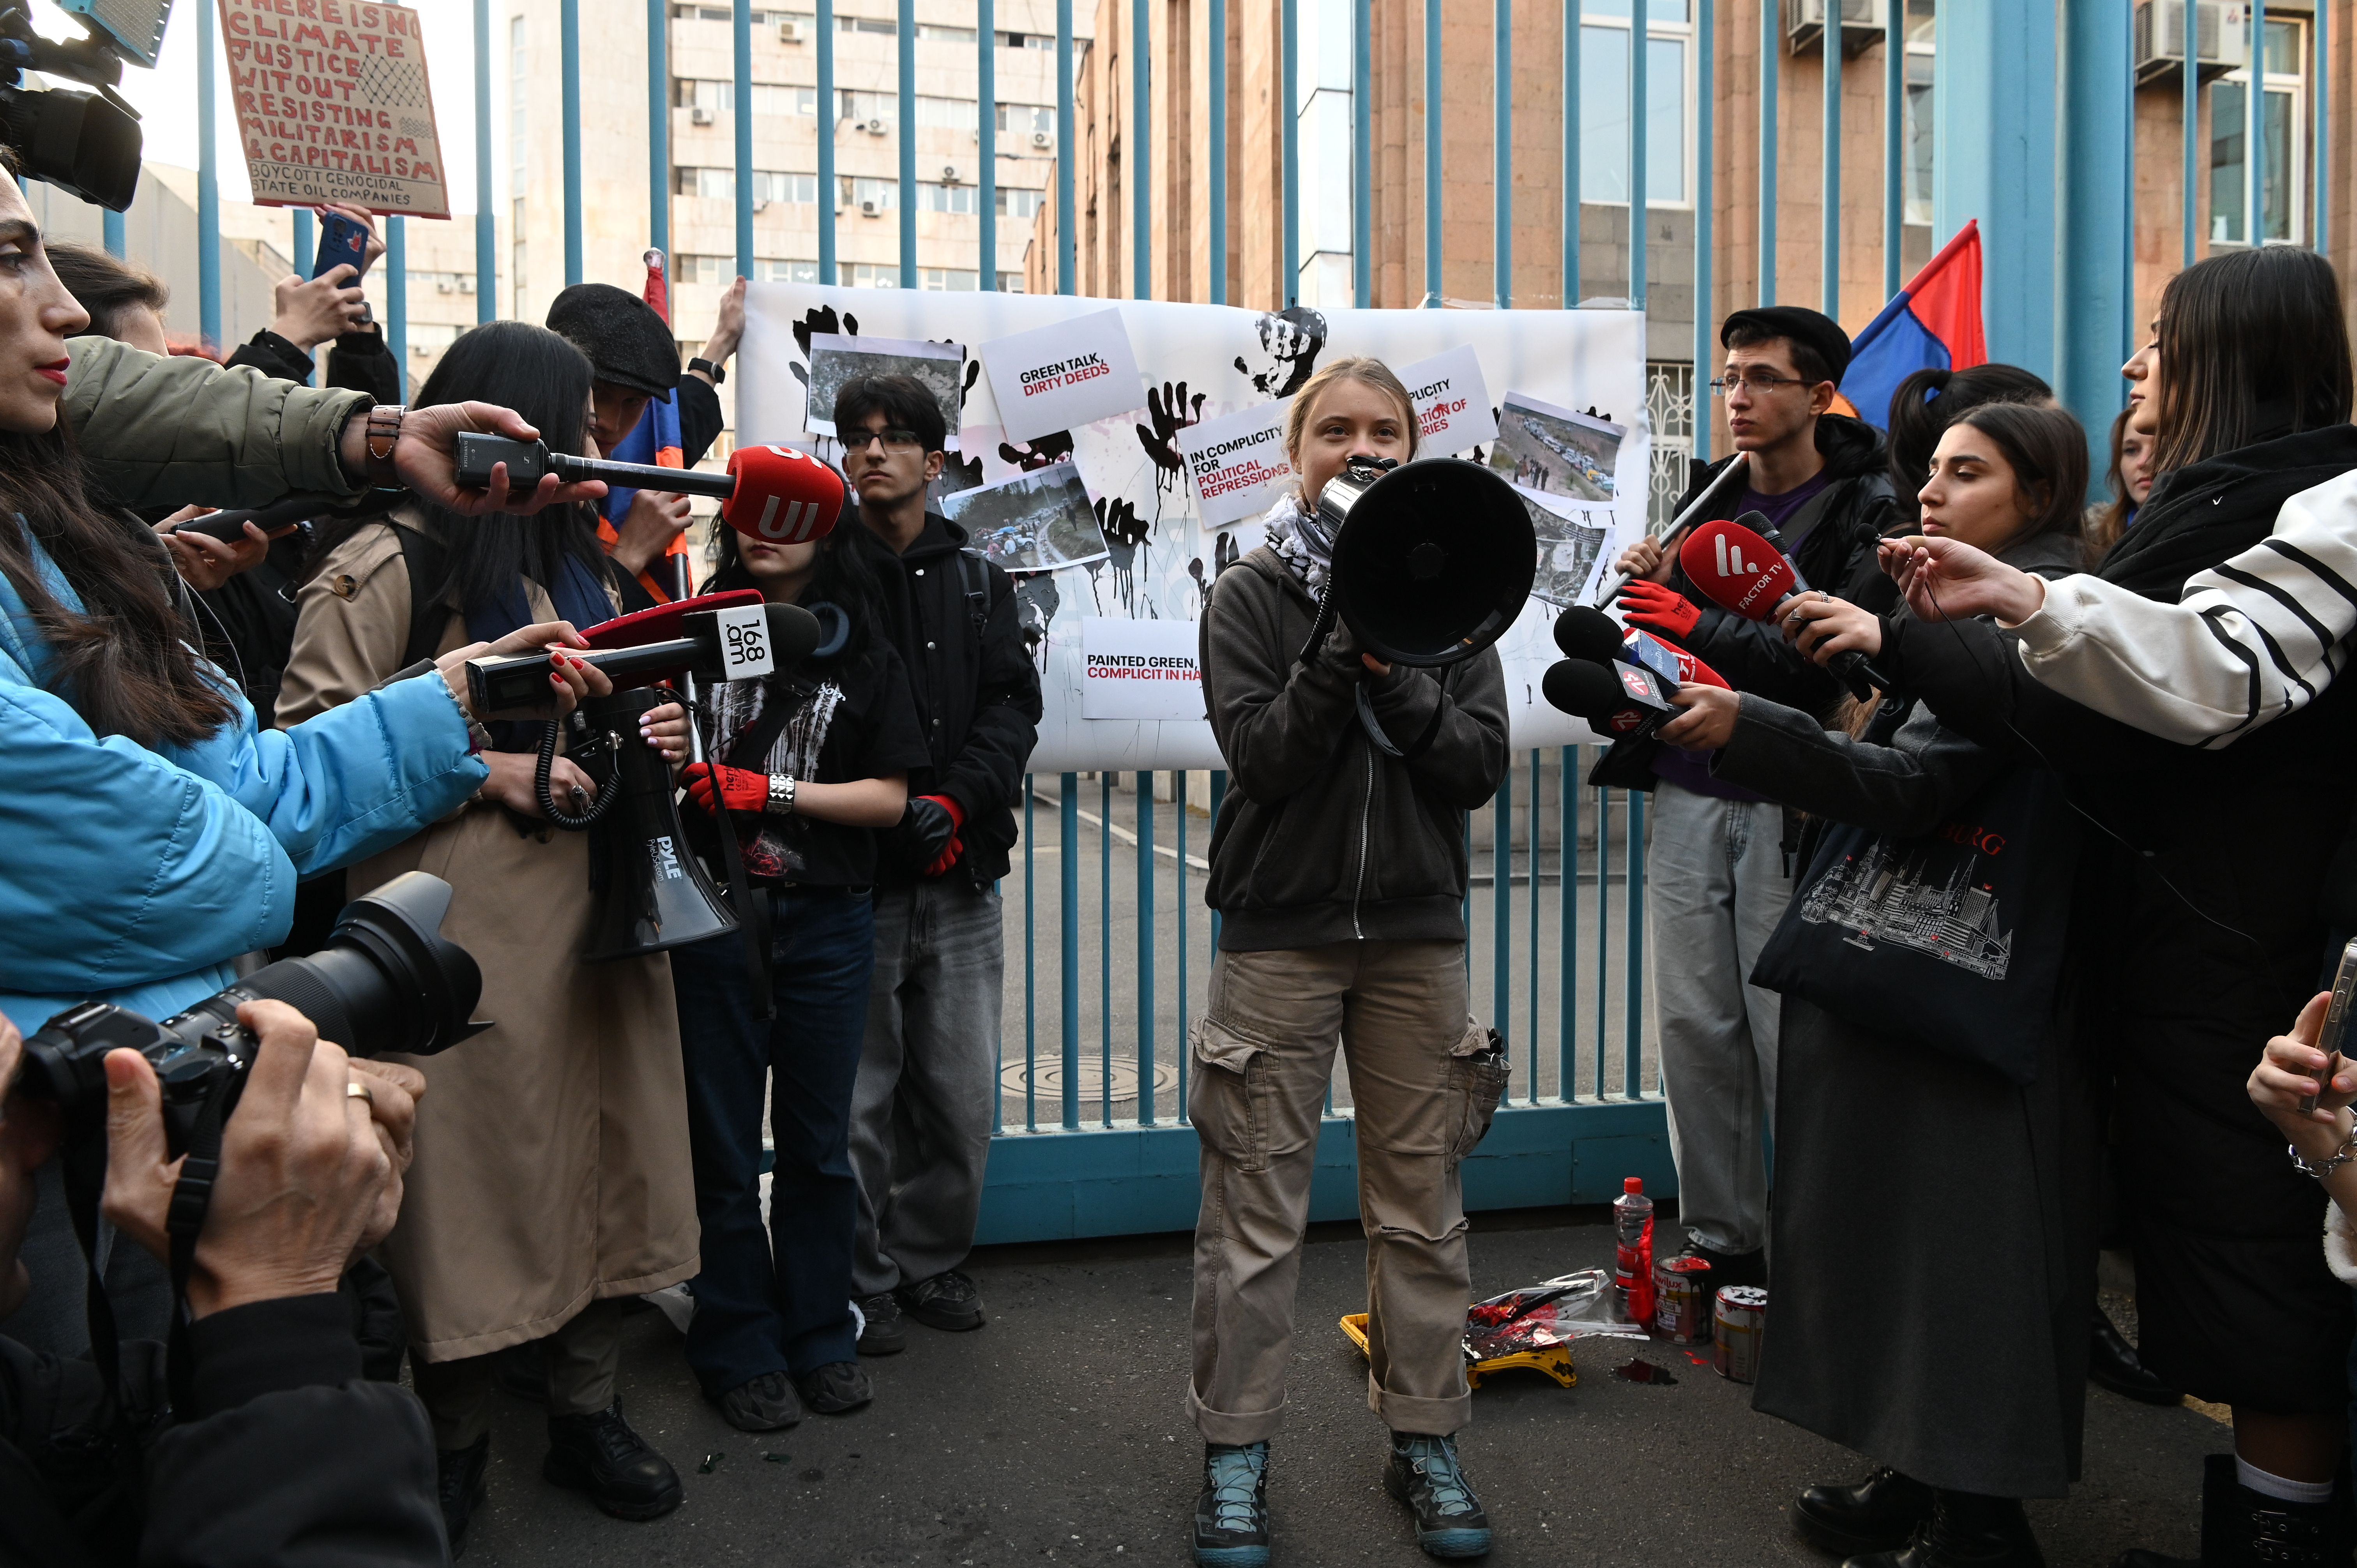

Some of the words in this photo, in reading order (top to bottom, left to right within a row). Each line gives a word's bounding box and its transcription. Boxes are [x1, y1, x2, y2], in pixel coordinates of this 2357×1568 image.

[229, 12, 405, 57] CLIMATE
[235, 0, 343, 24] HERE
[350, 4, 380, 28] IS
[385, 10, 421, 40] NO
[230, 38, 362, 77] JUSTICE
[234, 65, 356, 101] WITOUT
[240, 91, 391, 129] RESISTING
[242, 117, 418, 156] MILITARISM
[250, 163, 322, 182] BOYCOTT
[326, 173, 404, 191] GENOCIDAL
[270, 143, 437, 181] CAPITALISM
[251, 179, 297, 196] STATE
[304, 184, 327, 198] OIL
[331, 188, 410, 205] COMPANIES
[1020, 362, 1066, 383] GREEN
[1066, 352, 1104, 370] TALK,
[1023, 376, 1062, 397] DIRTY
[1064, 363, 1110, 385] DEEDS
[1452, 398, 1467, 412] OF
[1190, 450, 1205, 464] IN
[1206, 425, 1283, 458] COMPLICITY
[1419, 418, 1449, 438] RIES
[1194, 459, 1221, 476] FOR
[1197, 459, 1262, 488] POLITICAL
[1201, 463, 1290, 500] REPRESSIONS
[1738, 574, 1772, 610] FACTOR
[1769, 562, 1783, 575] TV
[726, 623, 746, 665] .am
[742, 619, 765, 662] 168
[1087, 667, 1163, 680] COMPLICIT
[1165, 669, 1179, 680] IN
[1088, 655, 1146, 667] PAINTED
[1148, 657, 1198, 671] GREEN,
[1642, 671, 1656, 698] ARMENIAN
[1650, 681, 1661, 700] REPORT
[1634, 710, 1659, 733] ARMENIAN
[1637, 720, 1655, 736] REPORT
[646, 839, 664, 881] PyleUSA.com
